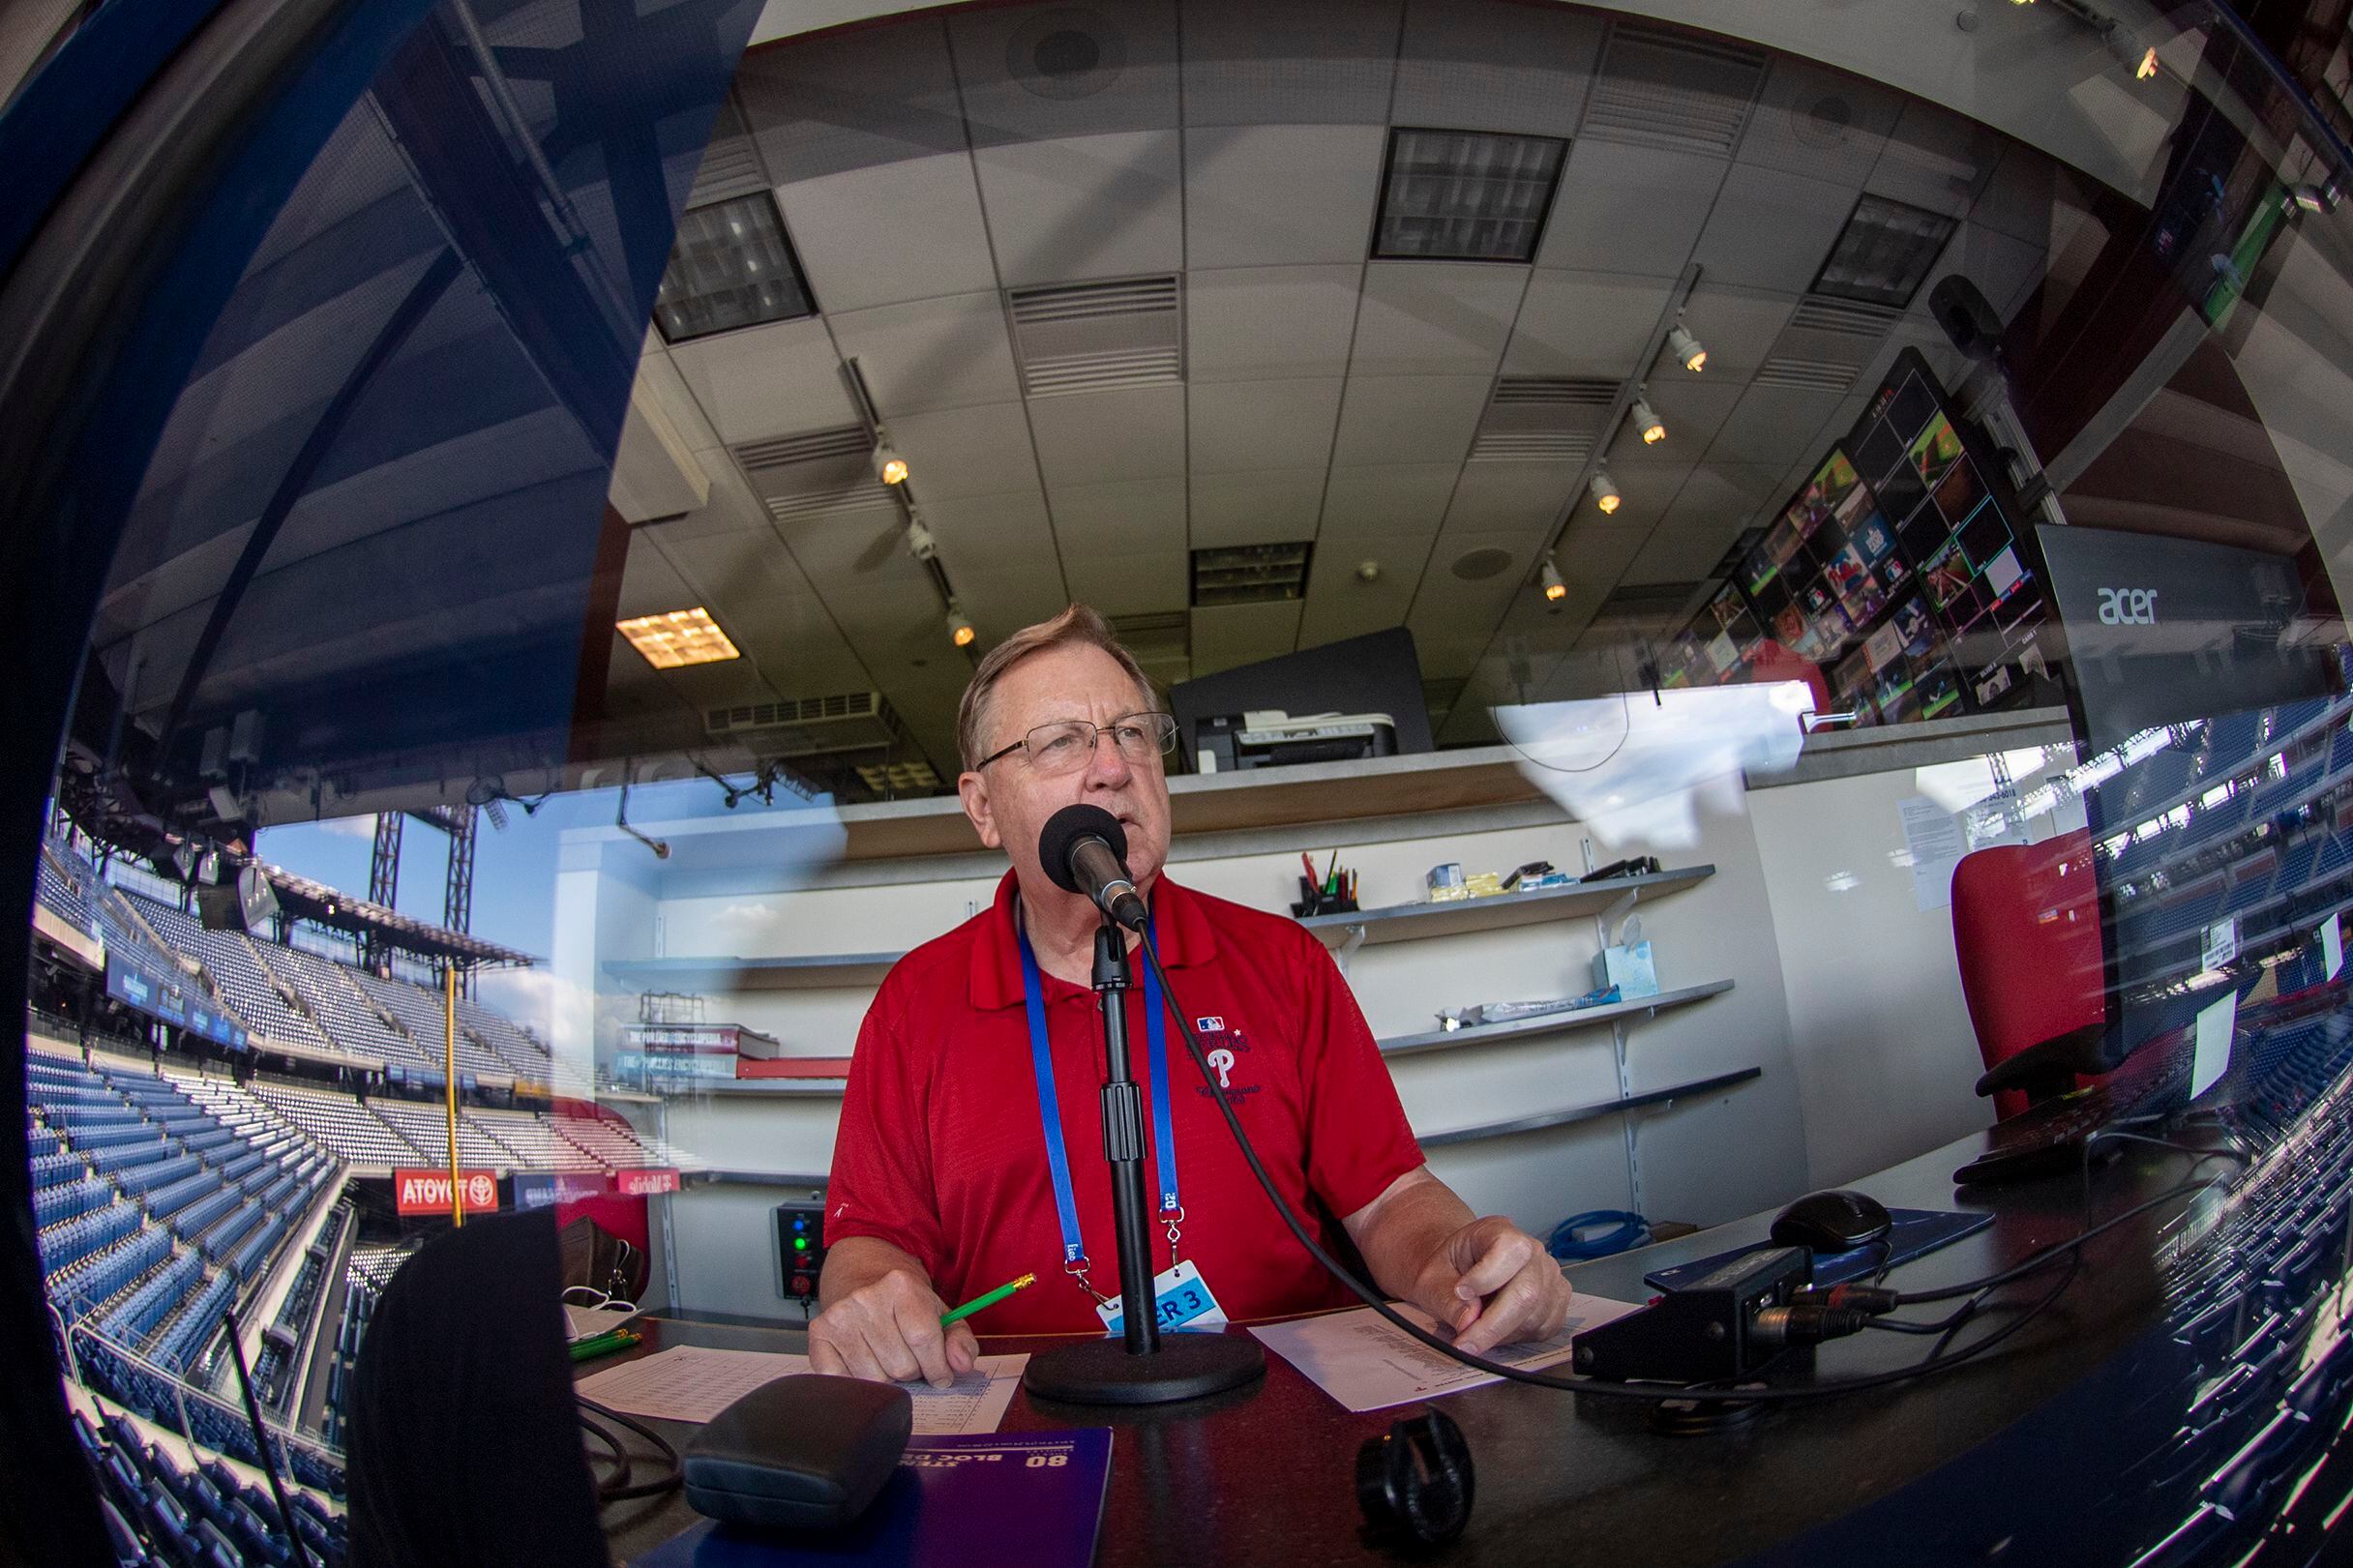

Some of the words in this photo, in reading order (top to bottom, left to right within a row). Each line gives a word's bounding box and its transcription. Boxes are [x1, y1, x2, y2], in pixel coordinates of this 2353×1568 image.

[2097, 588, 2158, 625] acer
[1207, 1049, 1235, 1087] P
[1183, 1290, 1202, 1310] 3
[1026, 1455, 1068, 1467] 80
